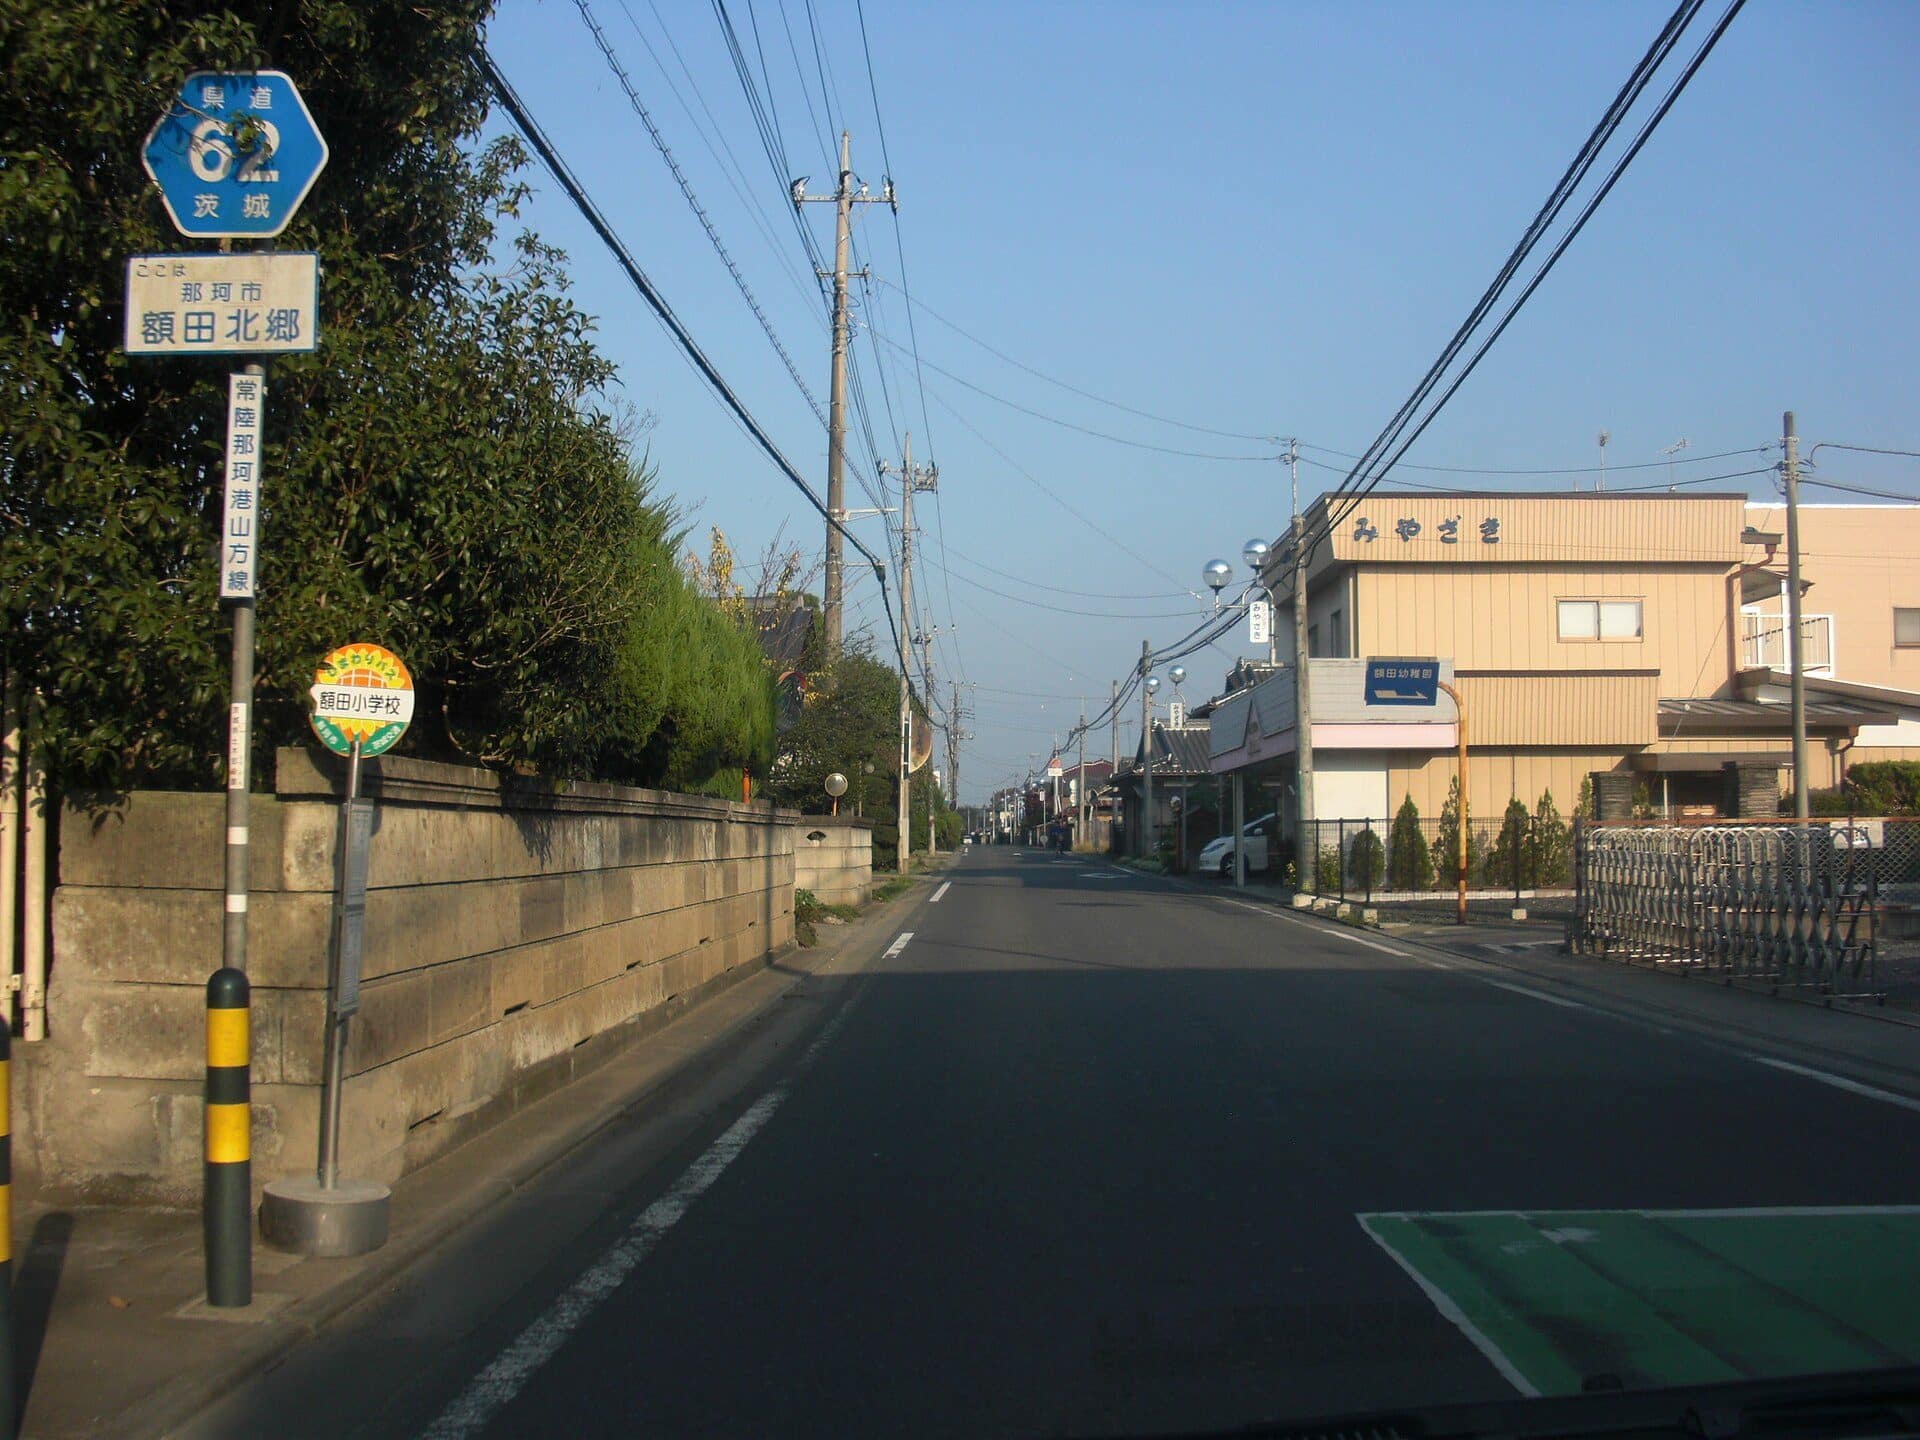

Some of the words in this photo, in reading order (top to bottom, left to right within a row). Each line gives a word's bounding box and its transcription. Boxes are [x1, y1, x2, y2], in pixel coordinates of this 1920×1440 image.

[202, 86, 273, 110] 県道
[189, 119, 280, 182] 62
[193, 194, 270, 219] 茨城
[136, 263, 186, 278] ここは
[181, 282, 263, 303] 那珂市
[141, 308, 300, 345] 額田北郷
[226, 380, 257, 592] 常陸那珂港山方線
[1353, 515, 1500, 544] みやざき
[1374, 668, 1433, 680] 額田幼稚園
[320, 691, 401, 715] 額田小学校
